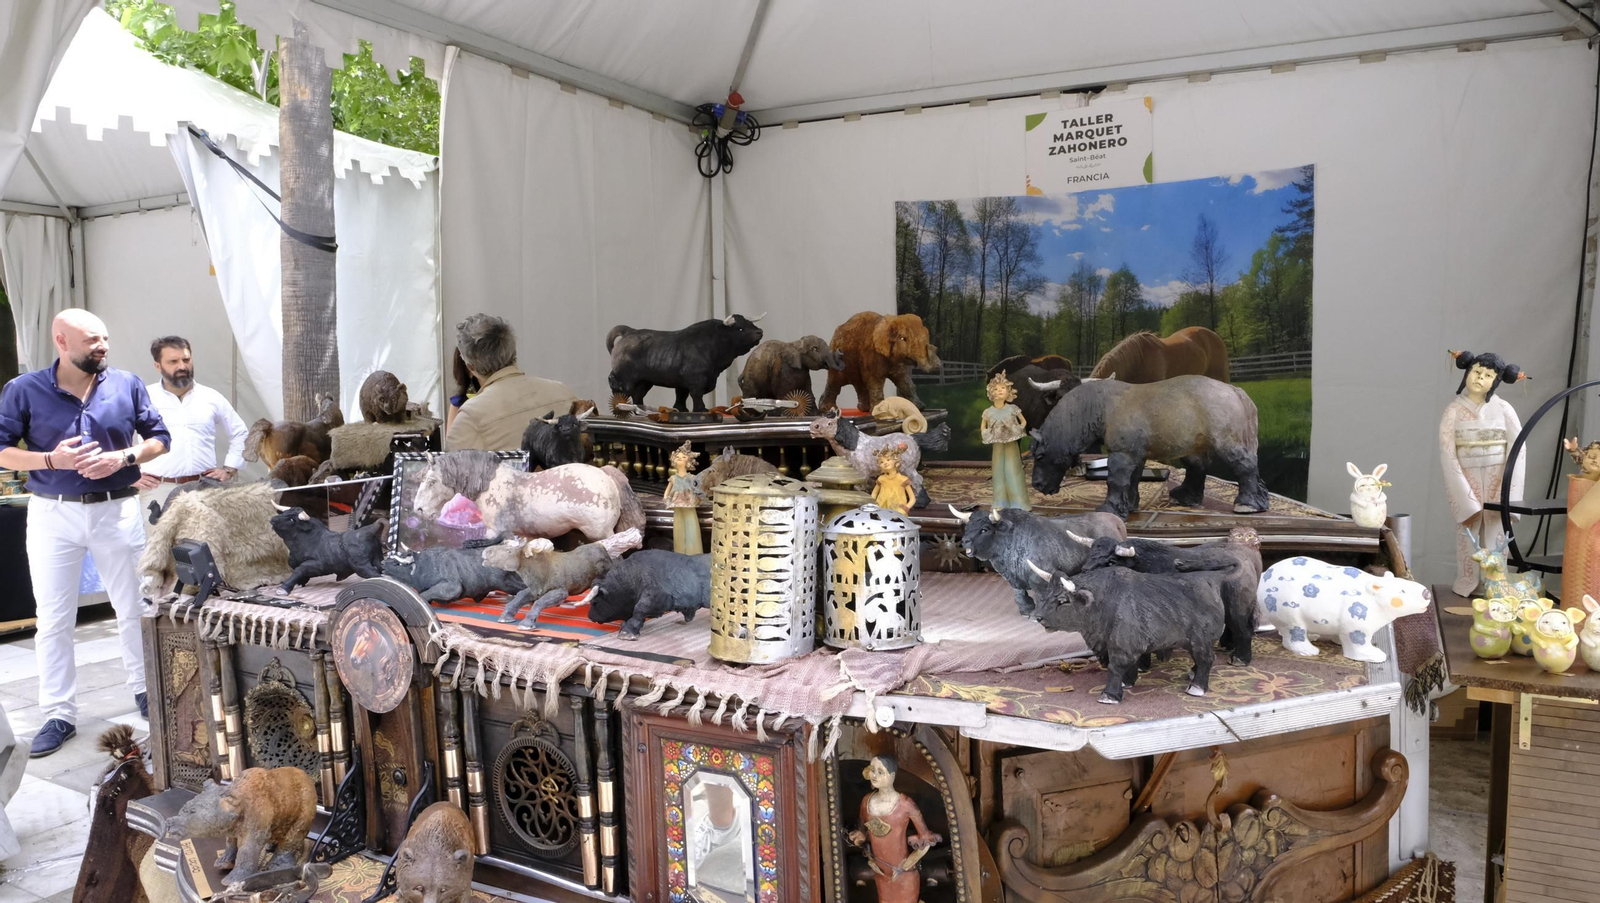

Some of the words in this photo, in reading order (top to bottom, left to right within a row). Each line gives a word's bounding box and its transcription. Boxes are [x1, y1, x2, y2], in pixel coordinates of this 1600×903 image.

[1061, 113, 1113, 129] TALLER
[1053, 124, 1123, 143] MARQUET
[1048, 136, 1128, 156] ZAHONERO
[1069, 153, 1106, 163] Saint-Béat
[1067, 172, 1110, 184] FRANCIA
